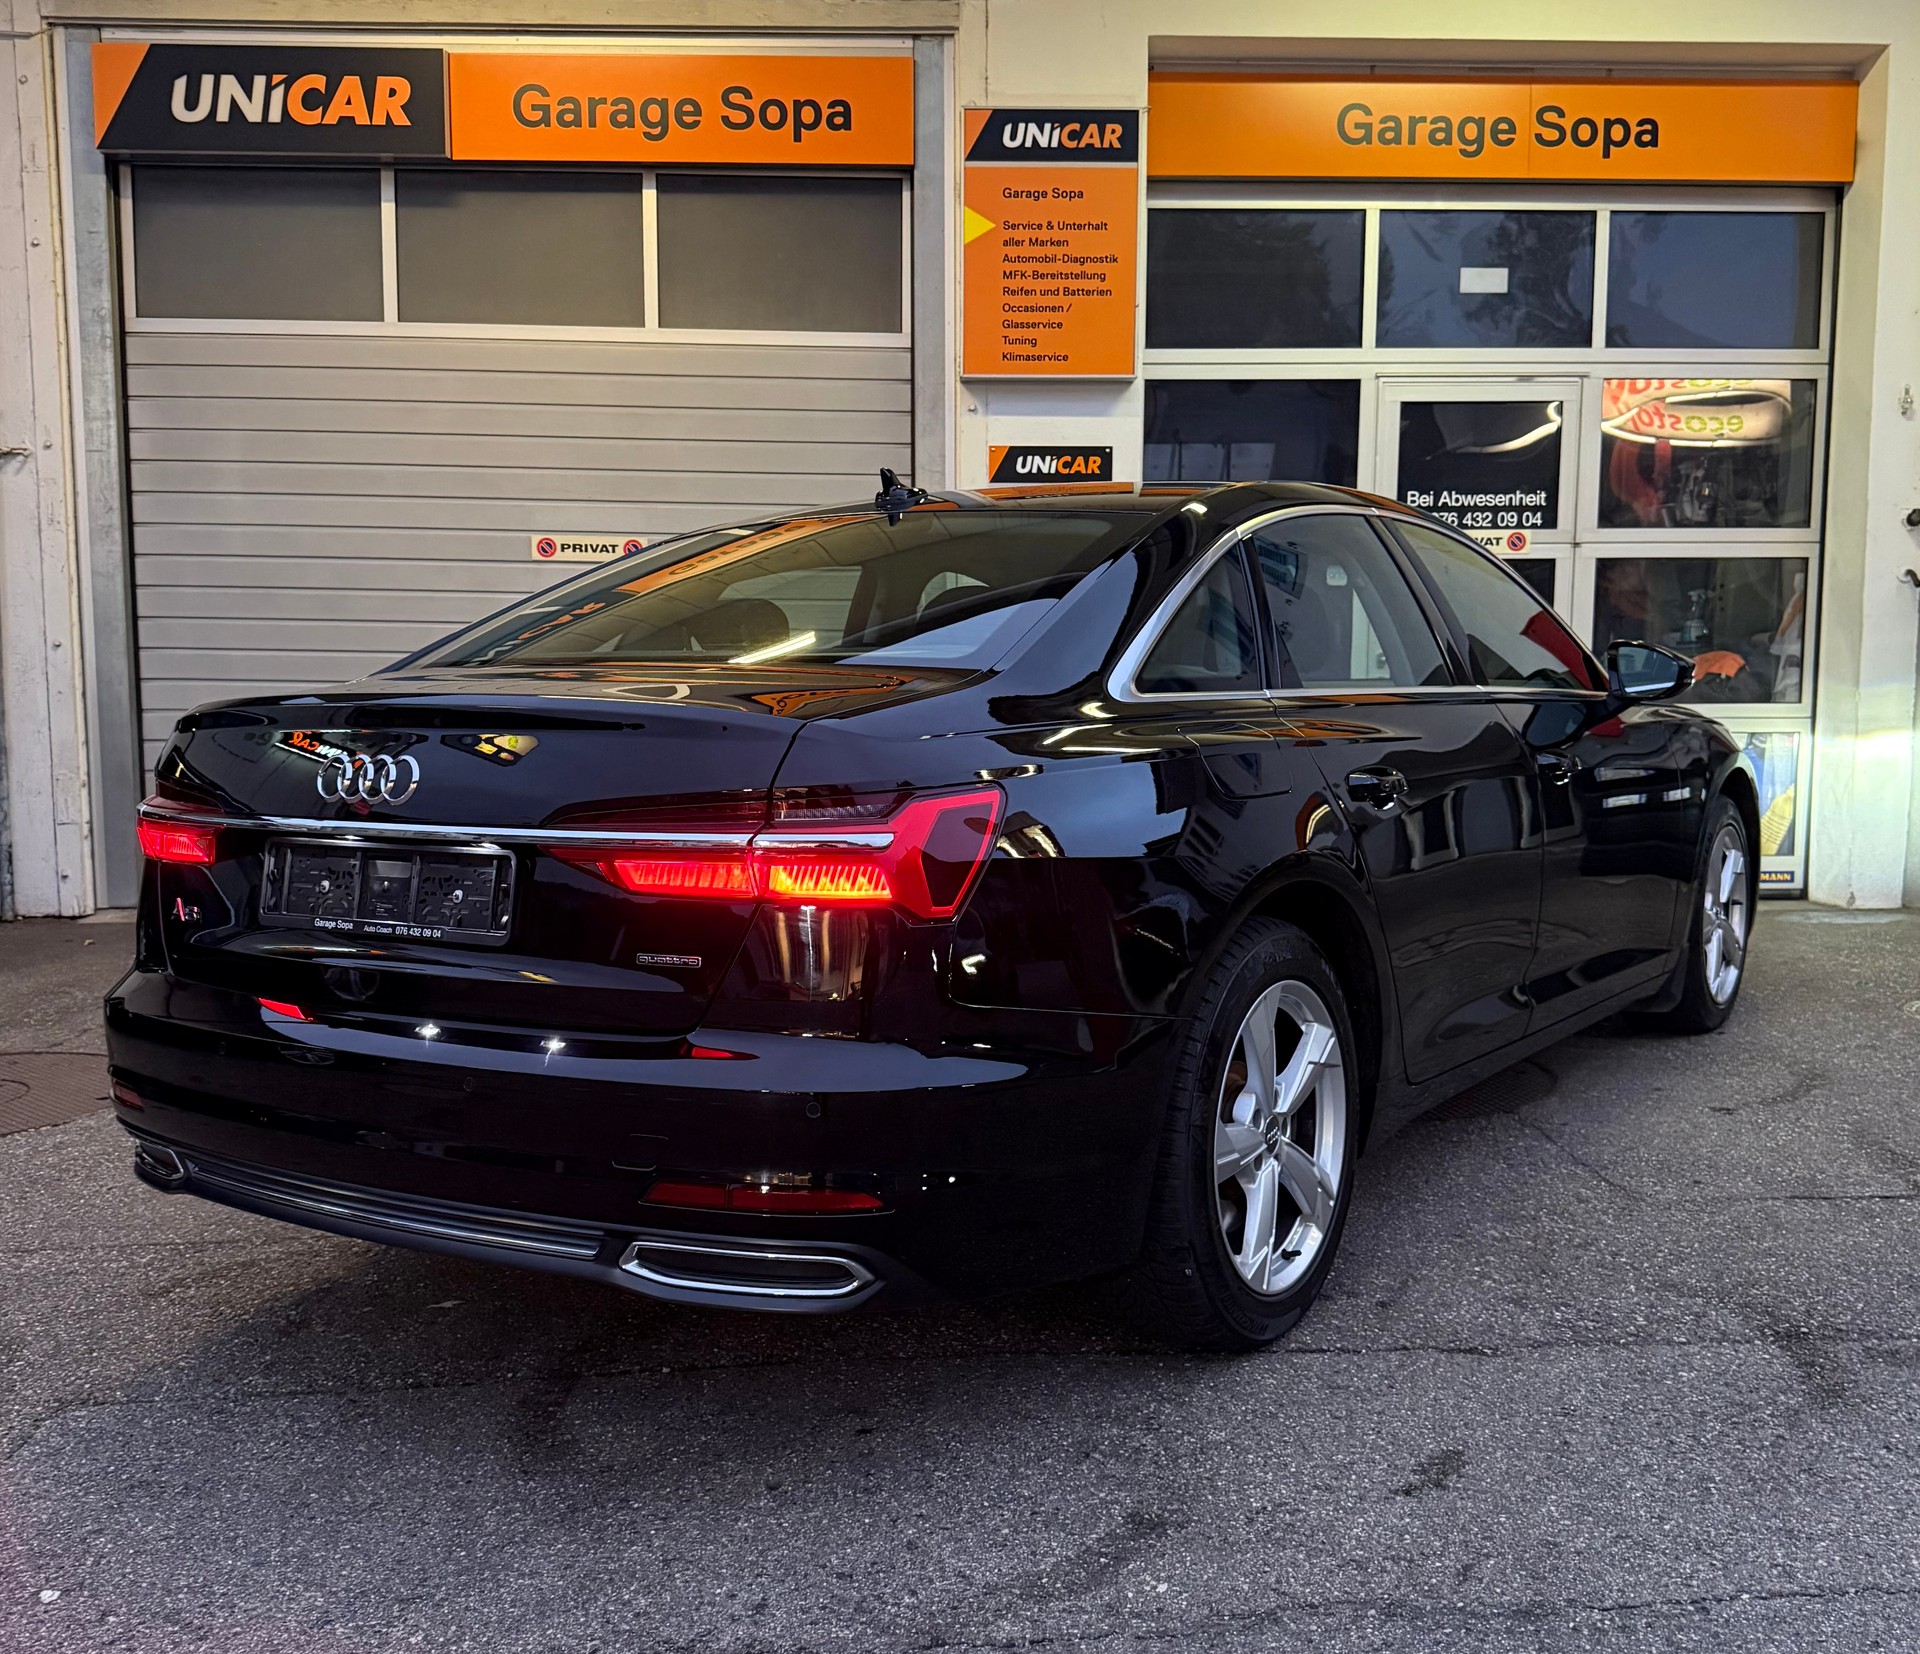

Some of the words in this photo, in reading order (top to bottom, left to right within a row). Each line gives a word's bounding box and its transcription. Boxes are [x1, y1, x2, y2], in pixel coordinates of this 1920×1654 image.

[512, 83, 703, 142] Garage
[720, 85, 852, 143] Sopa
[1337, 103, 1517, 159] Garage
[1534, 105, 1659, 159] Sopa
[1002, 187, 1048, 201] Garage
[1051, 187, 1084, 201] Sopa
[1003, 220, 1043, 231] Service
[1046, 220, 1054, 230] &
[1057, 221, 1108, 231] Unterhalt
[1002, 237, 1025, 247] aller
[1028, 237, 1069, 247] Marken
[1002, 254, 1118, 266] Automobil-Diagnostik
[1002, 270, 1106, 282] MFK-Bereitstellung
[1002, 286, 1037, 296] Reifen
[1039, 286, 1060, 296] und
[1062, 286, 1112, 296] Batterien
[1002, 303, 1064, 313] Occasionen
[1002, 319, 1063, 329] Glasservice
[1002, 335, 1037, 348] Tuning
[1001, 351, 1069, 362] Klimaservice
[1406, 491, 1433, 507] Bei
[1437, 490, 1547, 507] Abwesenheit
[1432, 512, 1458, 527] 76
[1462, 511, 1492, 527] 432
[1497, 511, 1518, 527] 09
[1522, 511, 1543, 527] 04
[560, 543, 619, 553] PRIVAT
[1759, 873, 1791, 881] MANN
[314, 918, 336, 930] Garage
[337, 920, 354, 929] Sopa
[363, 924, 376, 932] Auto
[376, 925, 393, 933] Coach
[395, 926, 408, 936] 076
[409, 927, 421, 936] 432
[422, 928, 432, 937] 09
[432, 929, 442, 938] 04
[639, 955, 698, 966] quattro
